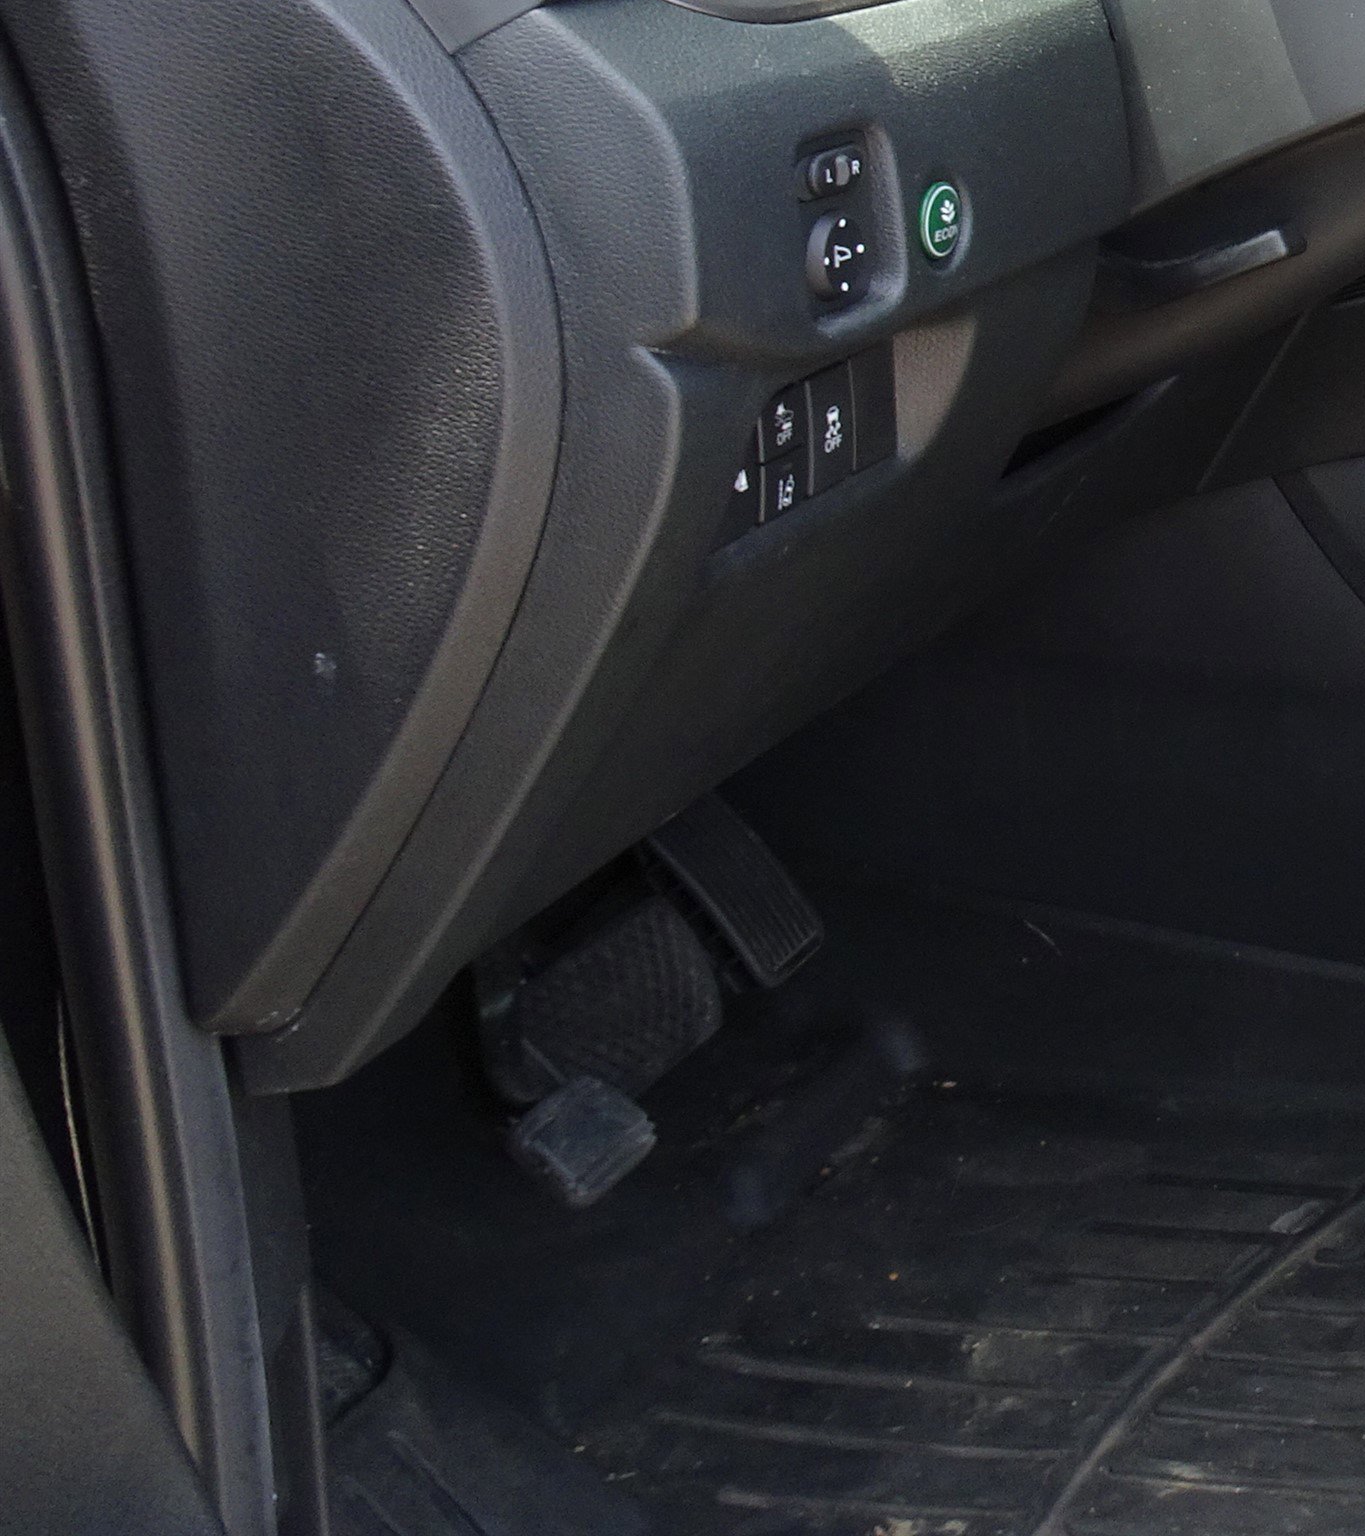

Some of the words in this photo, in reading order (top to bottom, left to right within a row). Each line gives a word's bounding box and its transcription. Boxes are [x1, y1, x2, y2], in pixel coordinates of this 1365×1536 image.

[825, 168, 834, 183] L
[851, 159, 861, 175] R
[776, 428, 793, 446] OFF
[824, 433, 843, 454] OFF
